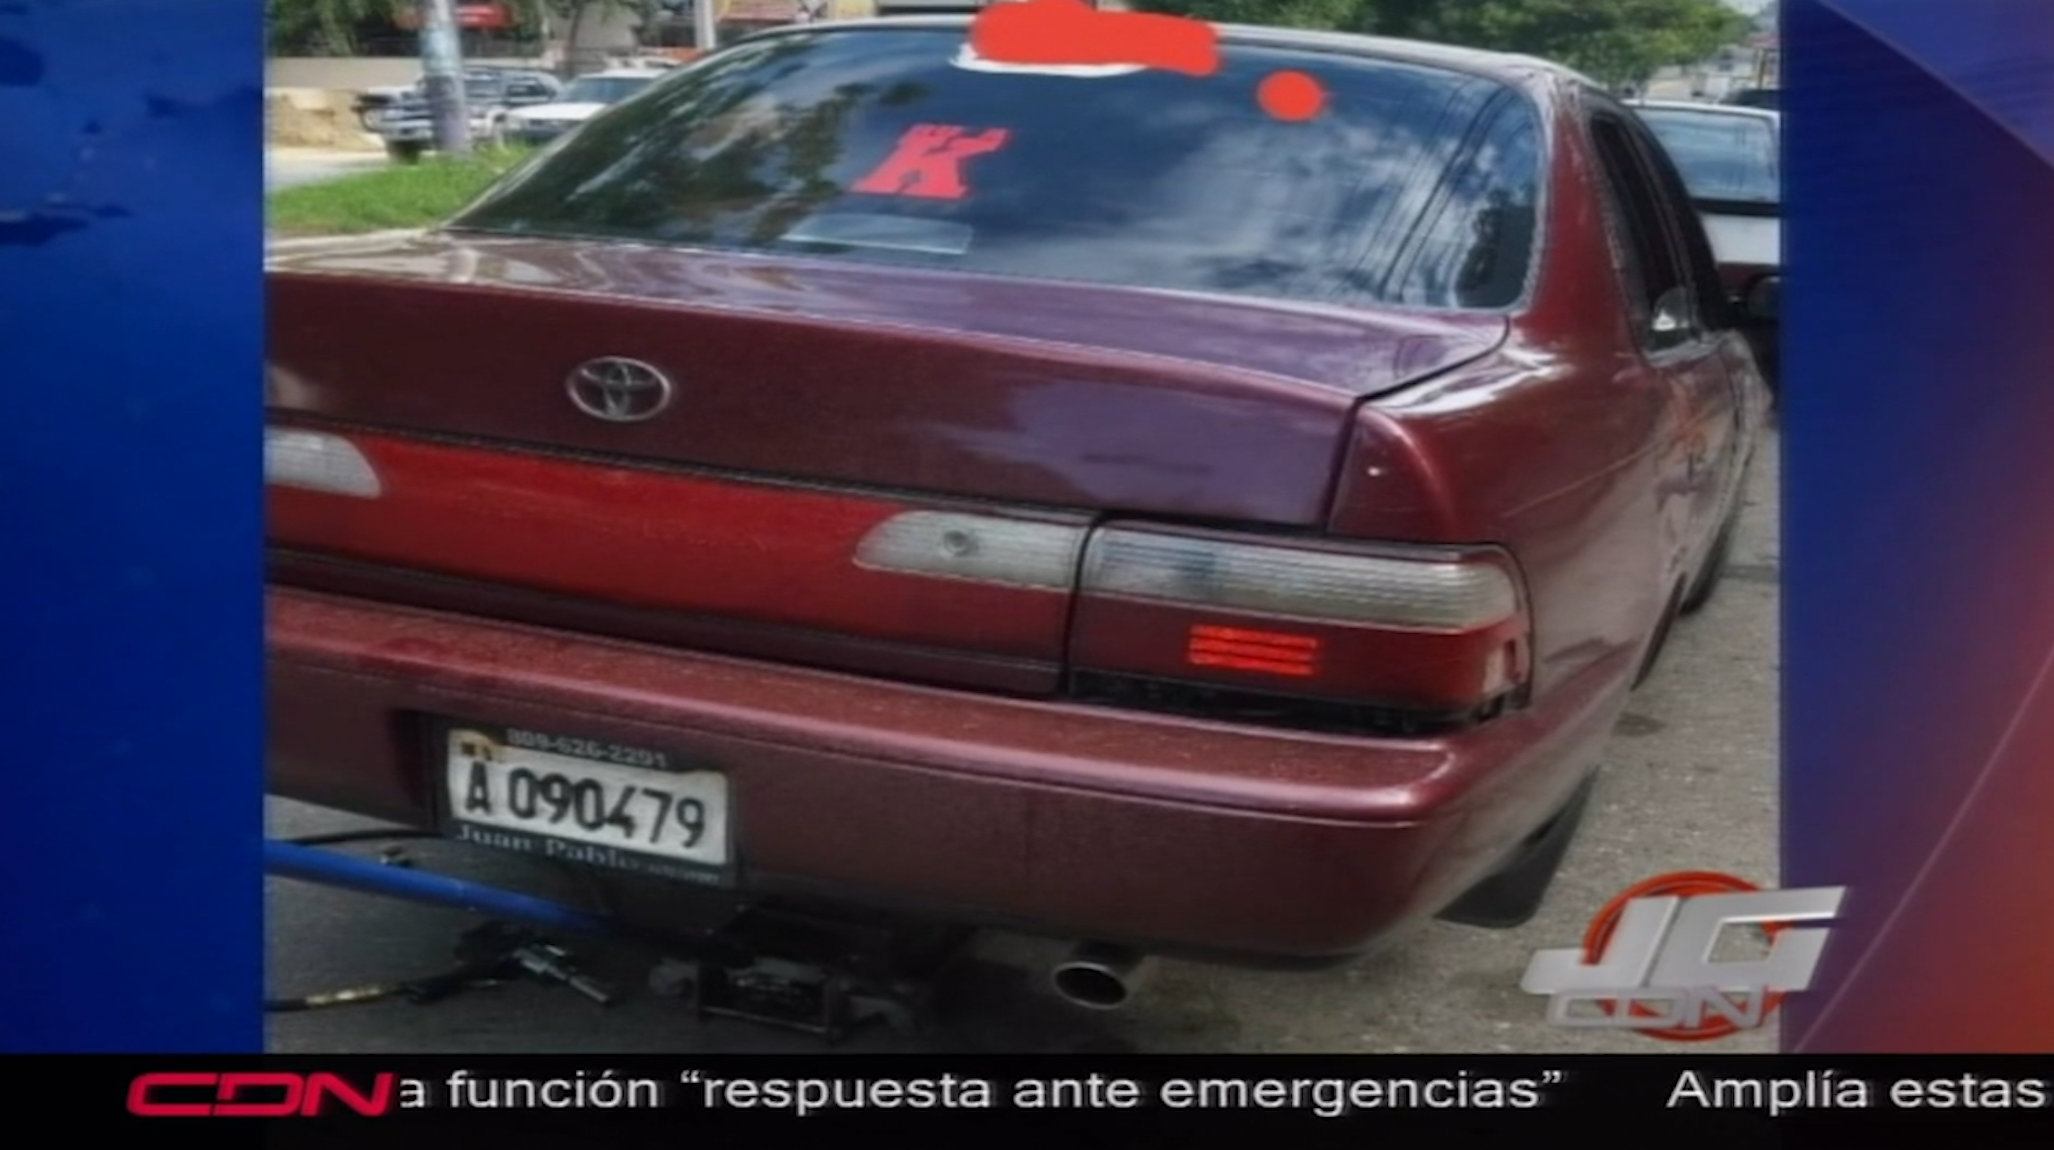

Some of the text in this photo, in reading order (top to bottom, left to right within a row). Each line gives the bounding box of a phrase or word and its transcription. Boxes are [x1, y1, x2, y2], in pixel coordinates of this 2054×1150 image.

[850, 123, 1011, 200] K
[464, 761, 706, 848] A 090479
